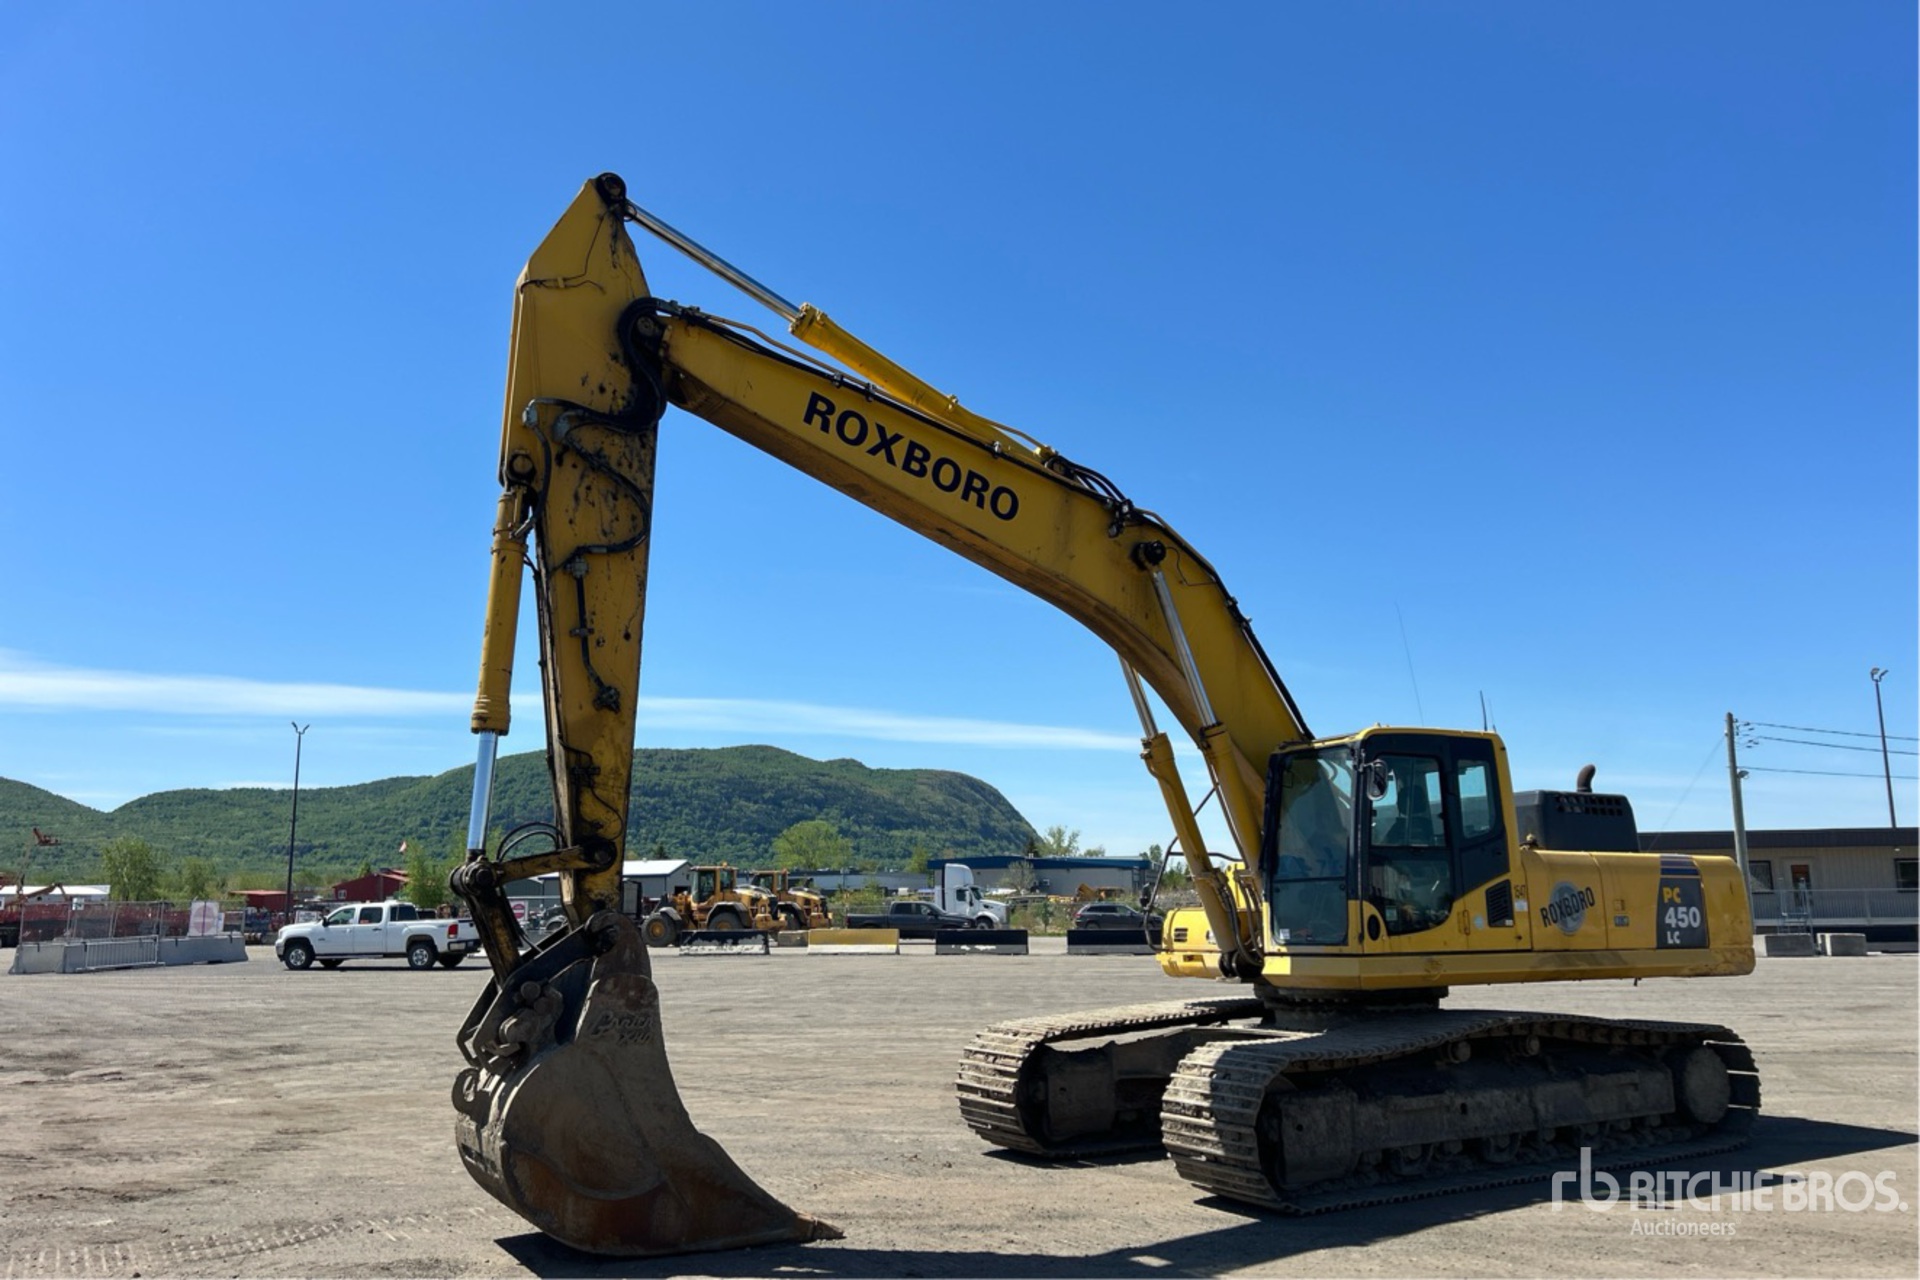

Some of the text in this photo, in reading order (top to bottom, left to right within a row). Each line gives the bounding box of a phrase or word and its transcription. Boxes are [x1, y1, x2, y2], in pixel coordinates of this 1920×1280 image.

[803, 391, 1020, 522] ROXBORO
[1662, 887, 1681, 904] PC
[1540, 886, 1596, 928] ROXBORO
[1665, 906, 1701, 928] 450
[1666, 931, 1681, 944] LC
